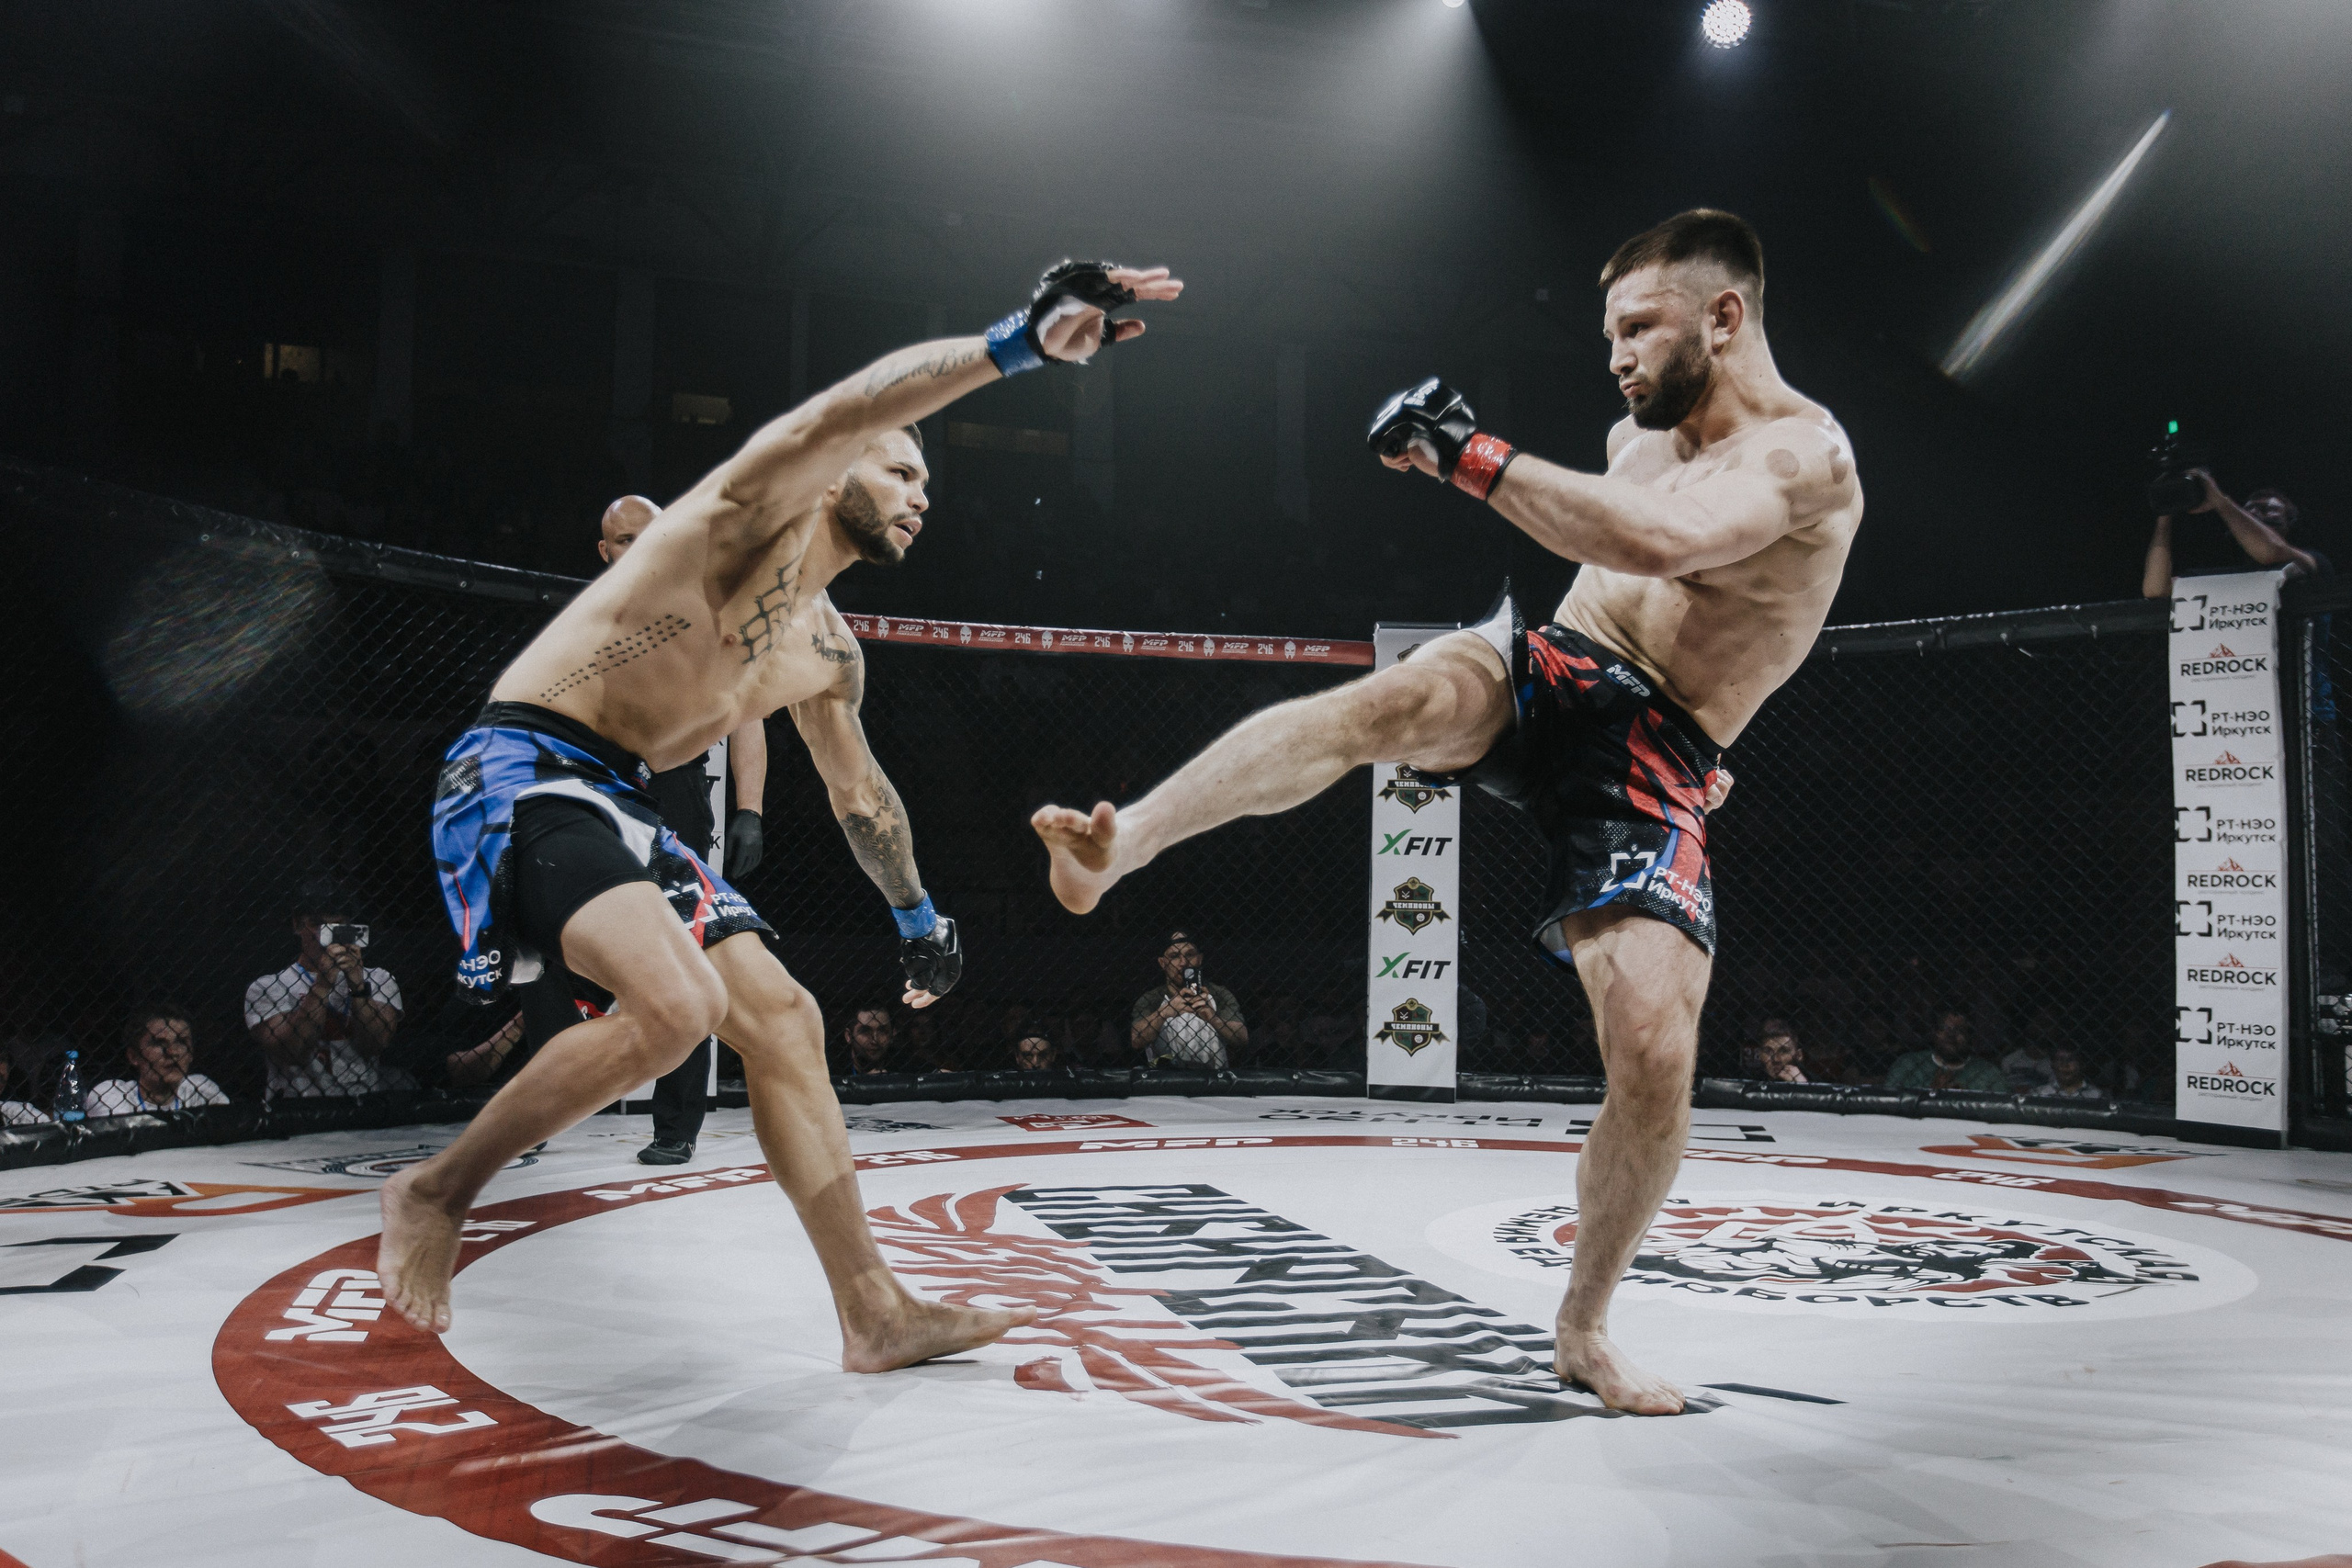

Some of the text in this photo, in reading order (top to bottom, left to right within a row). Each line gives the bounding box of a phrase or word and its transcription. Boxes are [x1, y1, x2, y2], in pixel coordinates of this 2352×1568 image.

[2209, 602, 2268, 616] РТ-НЭО
[2209, 616, 2268, 631] Иркутск
[854, 619, 870, 633] 246
[898, 623, 924, 632] MFP
[933, 626, 949, 639] 246
[979, 629, 1007, 637] MFP
[1014, 632, 1031, 644] 246
[1061, 634, 1088, 643] MFP
[1094, 636, 1111, 648] 246
[1142, 638, 1169, 647] MFP
[1178, 640, 1194, 652] 246
[1223, 642, 1250, 650] MFP
[1257, 643, 1274, 655] 246
[1304, 644, 1331, 653] MFP
[2180, 657, 2268, 677] REDROCK
[1606, 663, 1651, 698] MFP
[2211, 710, 2270, 724] РТ-НЭО
[2211, 724, 2271, 739] Иркутск
[2185, 765, 2275, 782] REDROCK
[2216, 818, 2276, 830] РТ-НЭО
[1376, 829, 1453, 856] XFIT
[2217, 831, 2277, 846] Иркутск
[2187, 873, 2278, 888] REDROCK
[1653, 866, 1713, 913] РТ-НЭО
[710, 892, 749, 906] РТ-НЭ
[1646, 878, 1711, 927] Иркутск
[2217, 914, 2277, 927] РТ-НЭО
[2217, 928, 2277, 942] Иркутск
[1374, 952, 1452, 980] XFIT
[2187, 969, 2278, 986] REDROCK
[2217, 1021, 2277, 1037] РТ-НЭО
[2217, 1036, 2277, 1051] Иркутск
[2187, 1075, 2277, 1097] REDROCK
[1078, 1137, 1273, 1150] MFP
[1390, 1137, 1479, 1148] 246
[1685, 1150, 1829, 1165] FP
[582, 1168, 766, 1201] MFP
[1930, 1170, 2058, 1188] 246
[1818, 1201, 2200, 1282] ИРКУТСКАЯ
